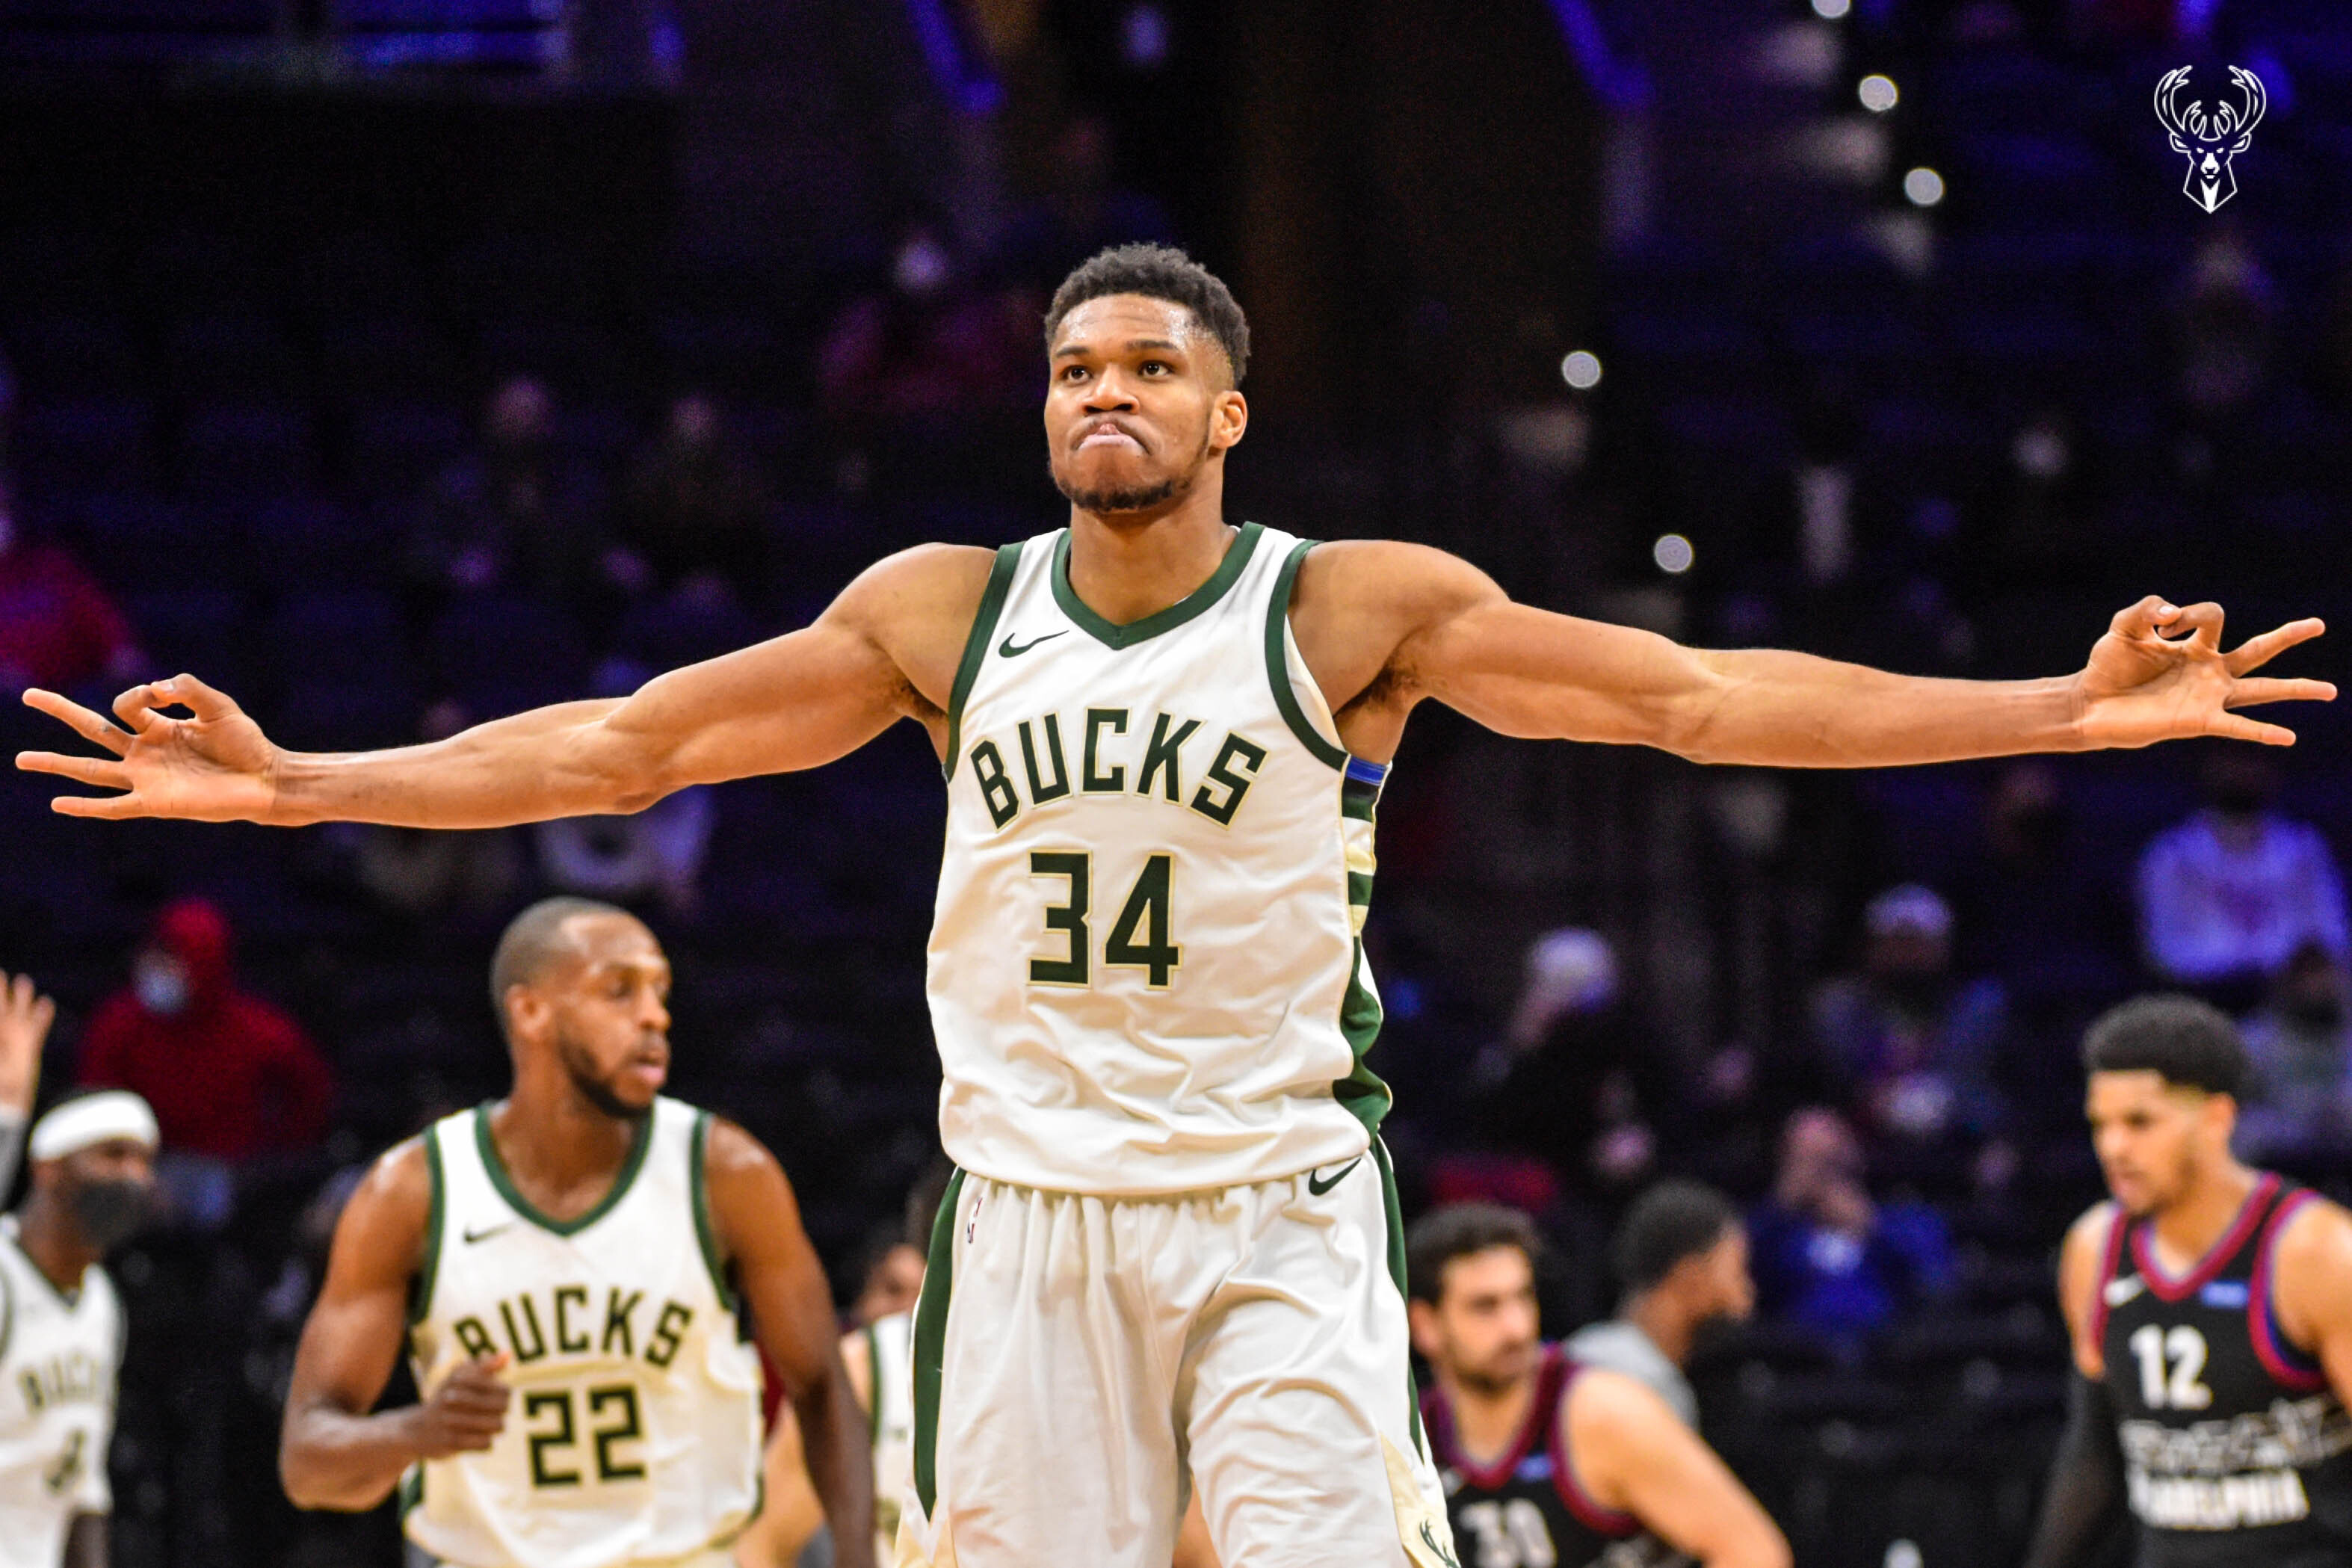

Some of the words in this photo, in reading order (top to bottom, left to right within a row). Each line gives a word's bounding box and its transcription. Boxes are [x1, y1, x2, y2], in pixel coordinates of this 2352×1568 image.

[970, 706, 1268, 833] BUCKS
[1027, 848, 1183, 990] 34
[454, 1284, 694, 1368] BUCKS
[2129, 1322, 2214, 1410] 12
[523, 1383, 648, 1487] 22
